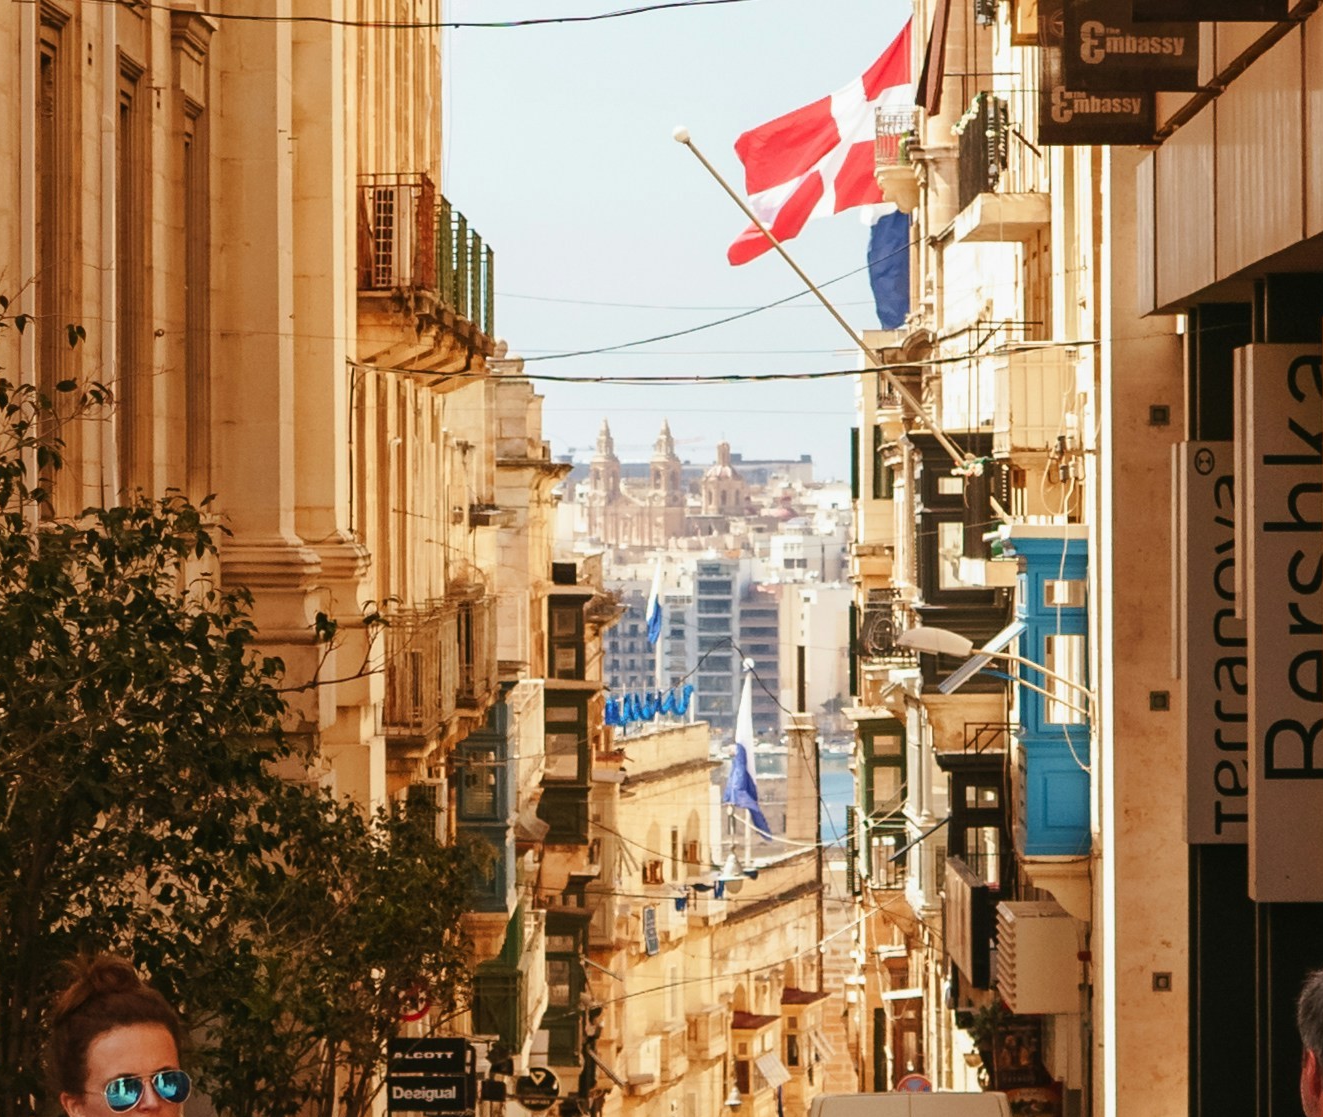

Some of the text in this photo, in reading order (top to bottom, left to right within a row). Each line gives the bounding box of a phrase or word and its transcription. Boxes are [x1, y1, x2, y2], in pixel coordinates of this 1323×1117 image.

[1080, 20, 1184, 64] Embassy
[1051, 86, 1141, 123] Embassy
[392, 1085, 457, 1102] Desigual
